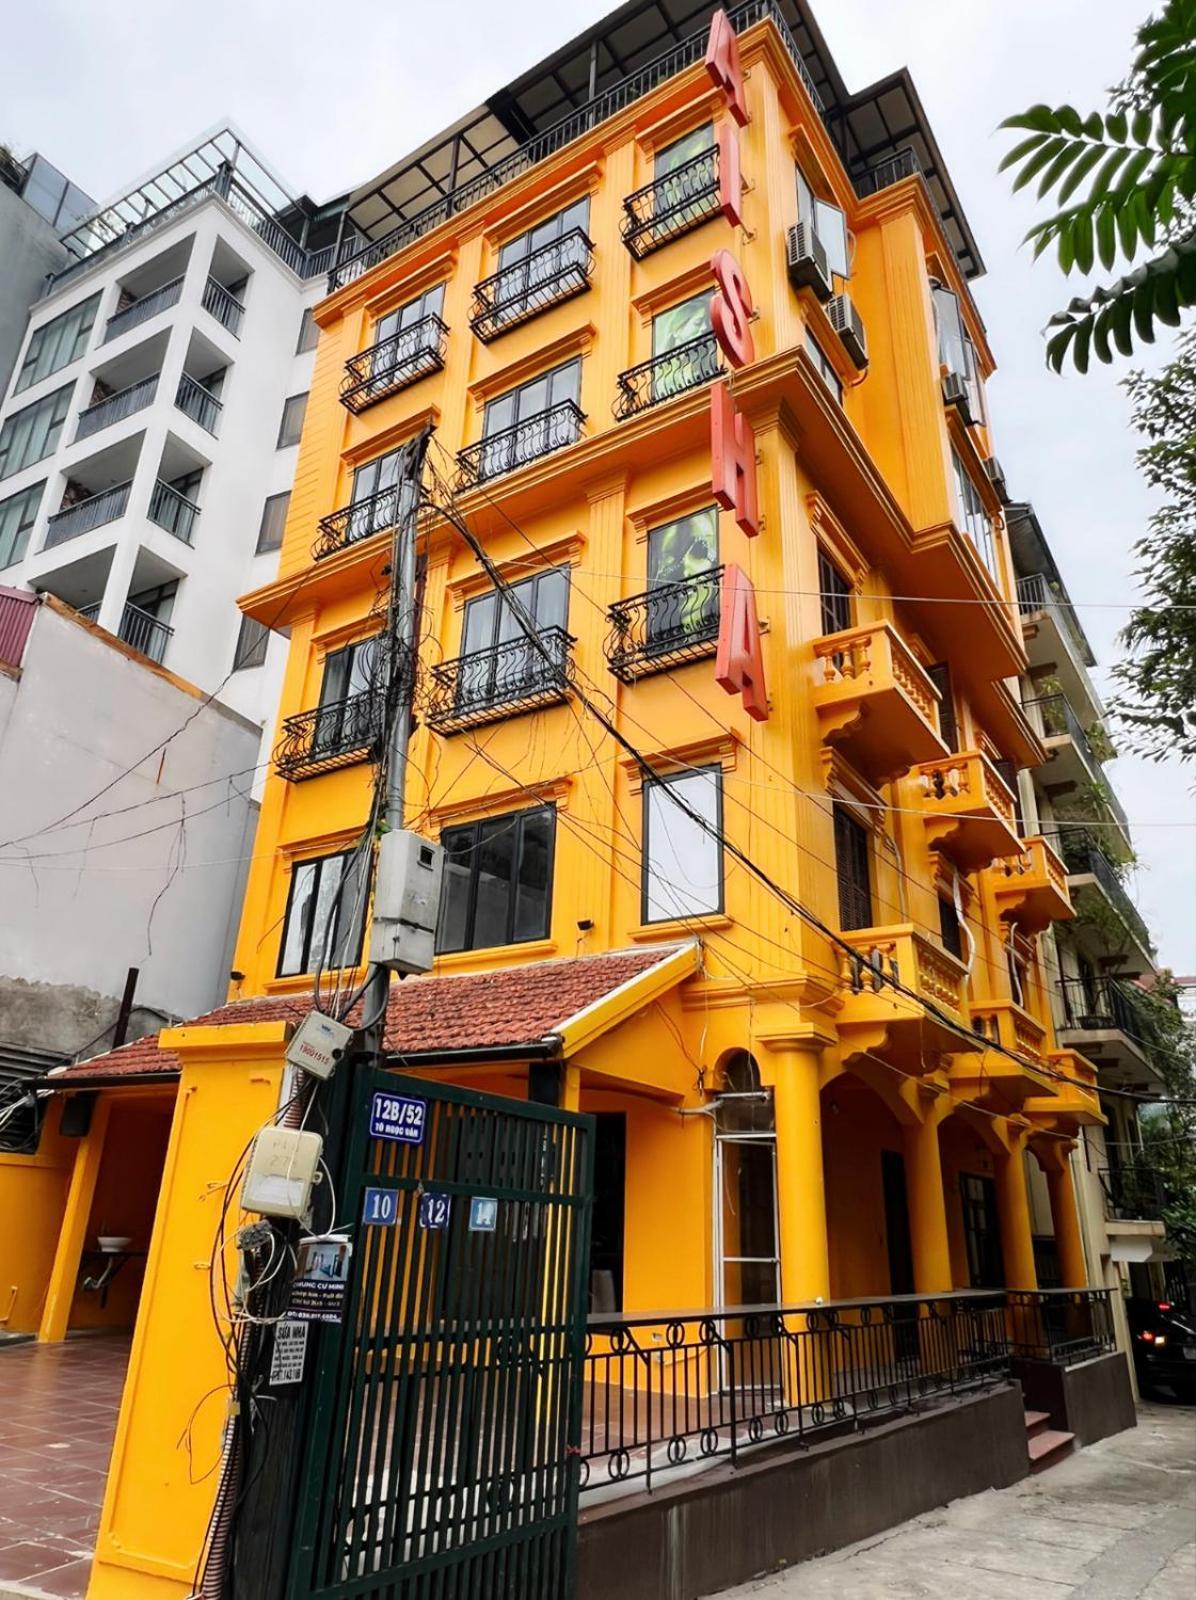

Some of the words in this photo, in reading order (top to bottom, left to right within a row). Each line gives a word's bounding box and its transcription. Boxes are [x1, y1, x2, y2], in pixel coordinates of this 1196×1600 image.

[705, 8, 769, 722] AISHA
[375, 1098, 423, 1125] 12B/52
[372, 1194, 391, 1219] 10
[427, 1198, 446, 1223] 12
